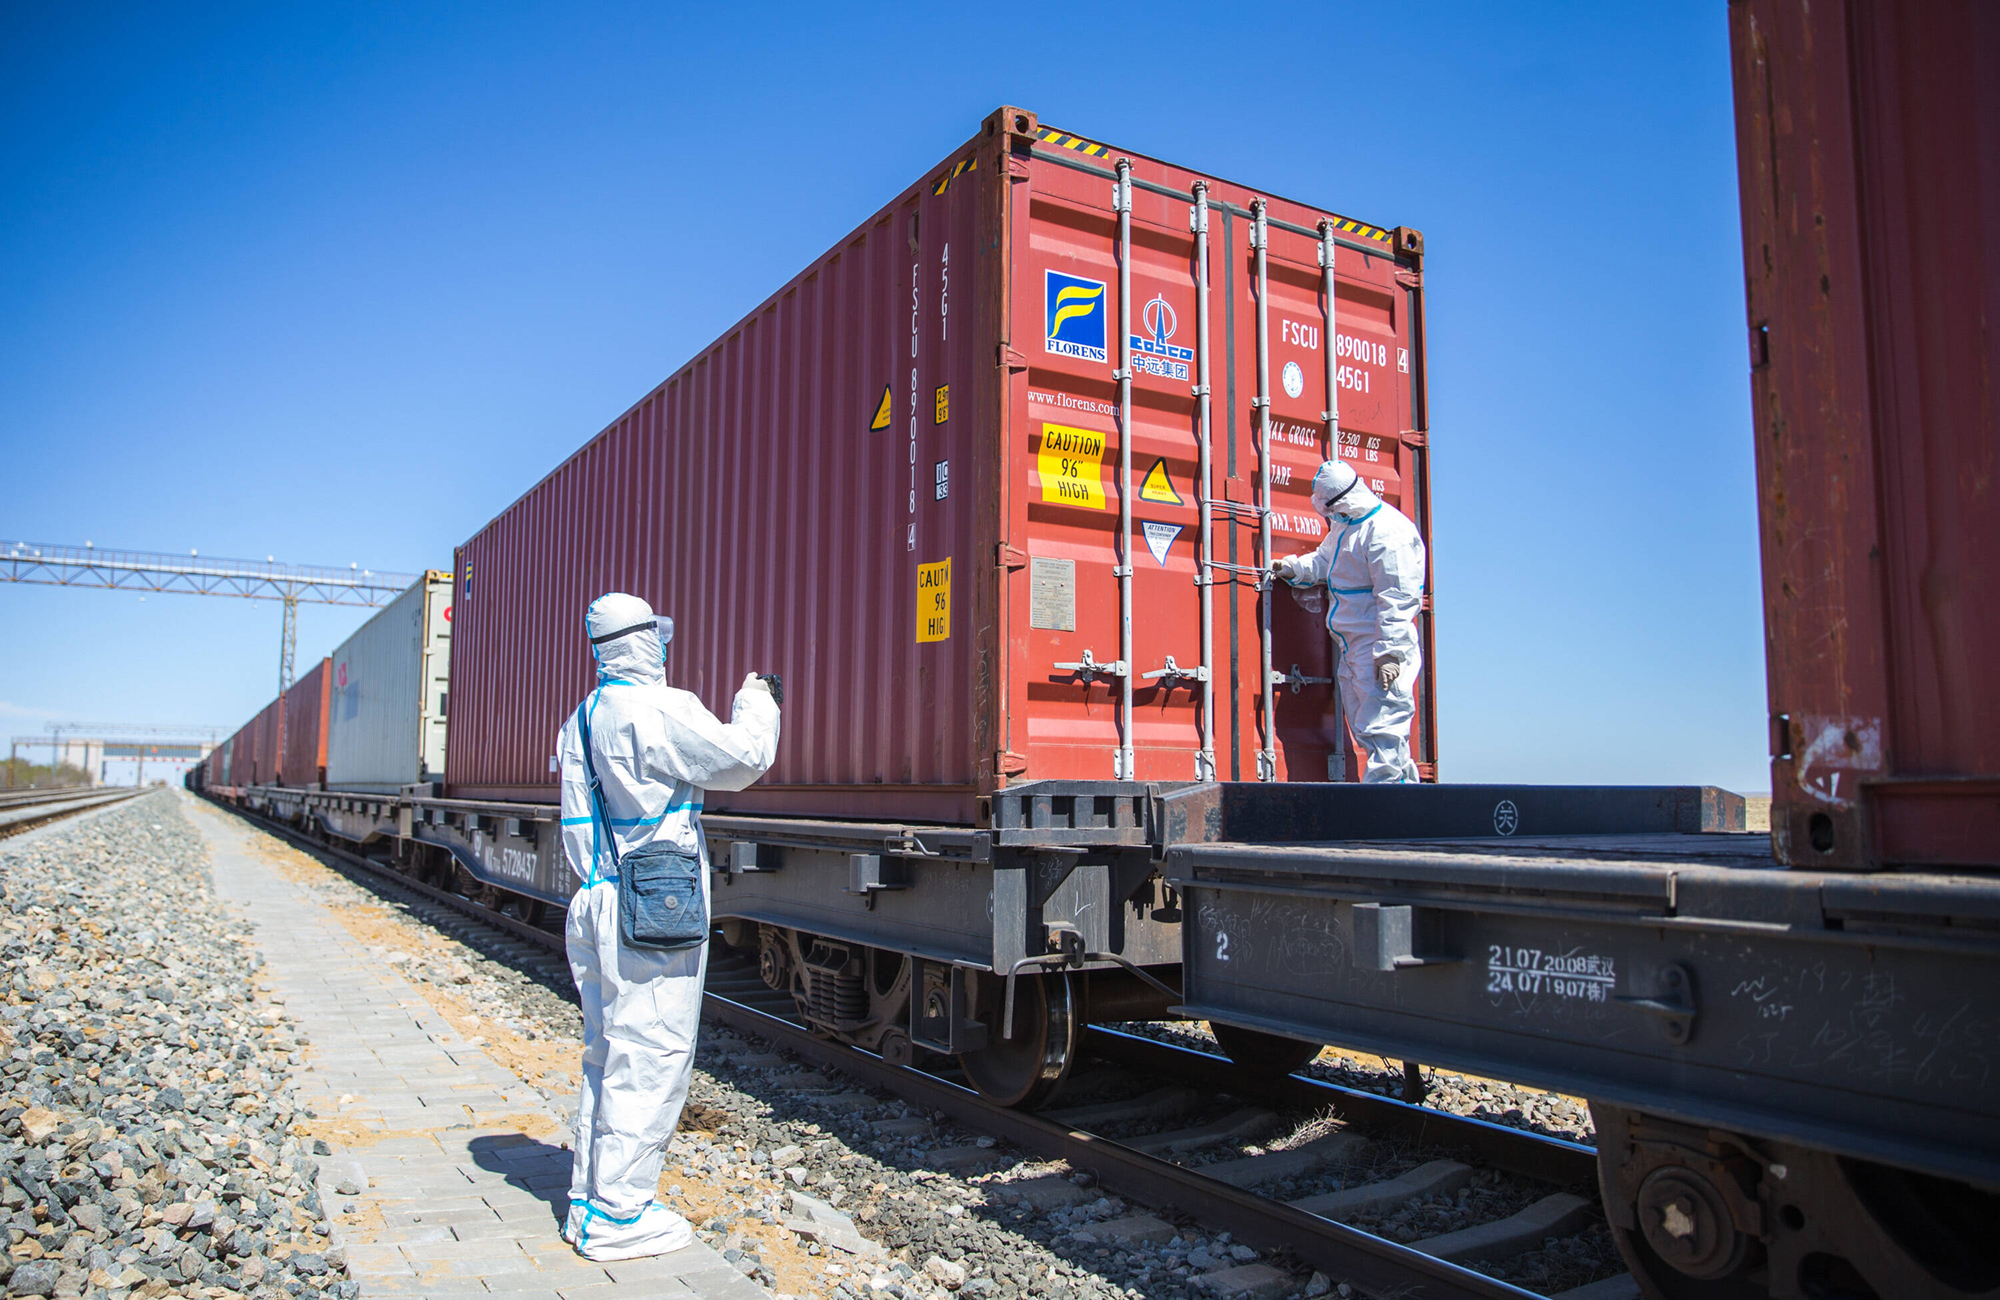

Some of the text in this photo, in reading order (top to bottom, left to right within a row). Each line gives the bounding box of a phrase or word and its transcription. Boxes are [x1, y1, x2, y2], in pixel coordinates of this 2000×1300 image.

[1047, 339, 1106, 361] FLORENS
[1130, 335, 1193, 361] COSCO
[1282, 319, 1408, 373] FSCU 890018 4
[1132, 354, 1188, 381] 中远集团
[1336, 365, 1369, 394] 45G1
[1028, 391, 1120, 416] www.florens.com
[909, 367, 917, 513] 890018
[1046, 431, 1101, 457] CAUTION
[1288, 424, 1316, 447] GROSS
[1366, 436, 1381, 450] KGS
[1365, 449, 1379, 462] LBS
[1058, 480, 1089, 500] HIGH
[1270, 464, 1292, 486] TARE
[1371, 478, 1385, 492] KGS
[1148, 524, 1176, 533] ATTENTION
[1271, 512, 1321, 536] MAX. CARGO
[908, 524, 916, 551] 4
[928, 617, 944, 636] HIG
[1216, 931, 1229, 961] 2
